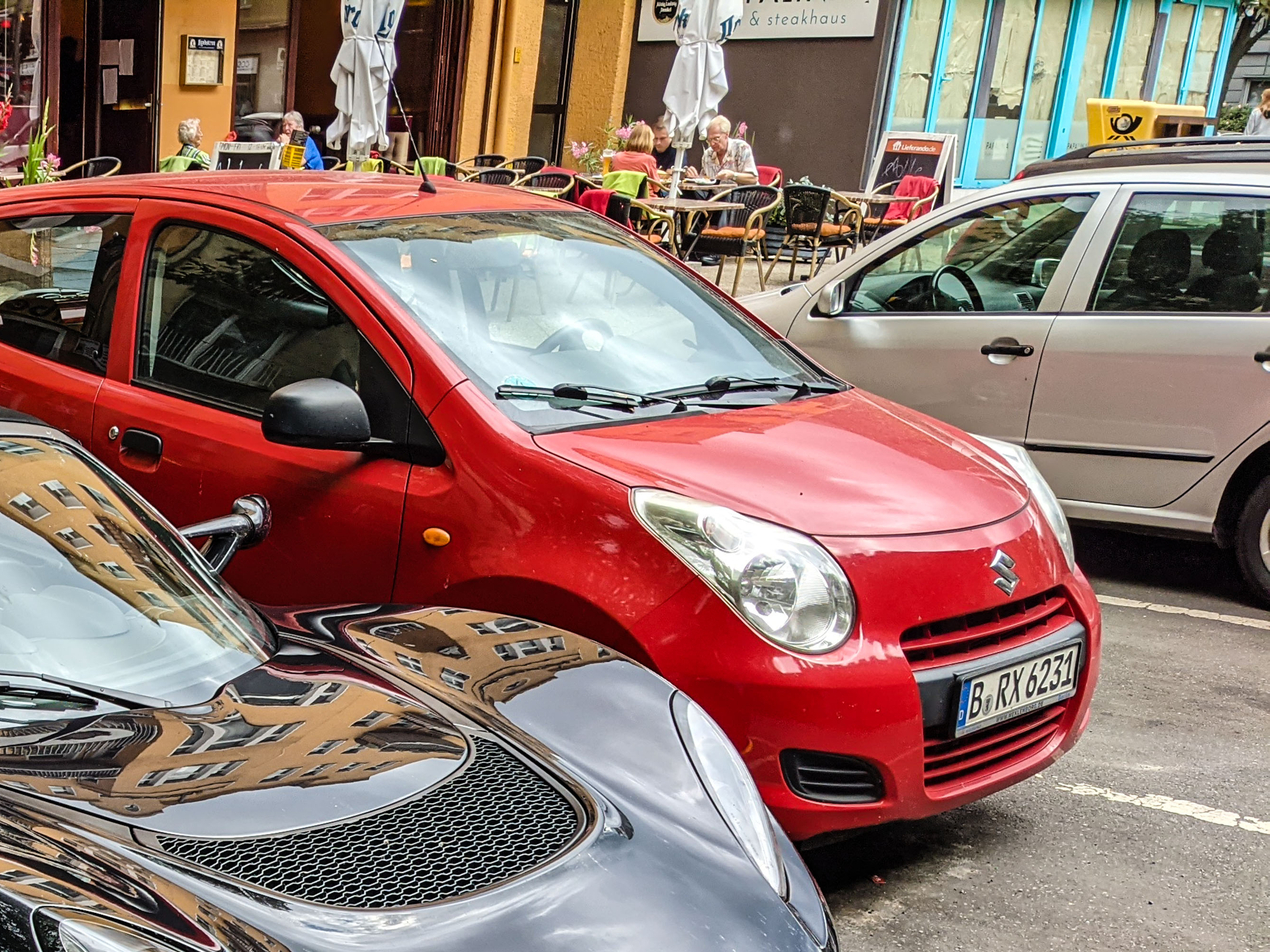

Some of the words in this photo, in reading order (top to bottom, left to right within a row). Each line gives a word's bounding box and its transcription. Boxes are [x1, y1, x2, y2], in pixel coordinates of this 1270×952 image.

[750, 10, 760, 26] &
[767, 9, 846, 26] steakhaus
[968, 681, 984, 720] B
[994, 666, 1025, 711] RX
[1025, 650, 1074, 699] 6231
